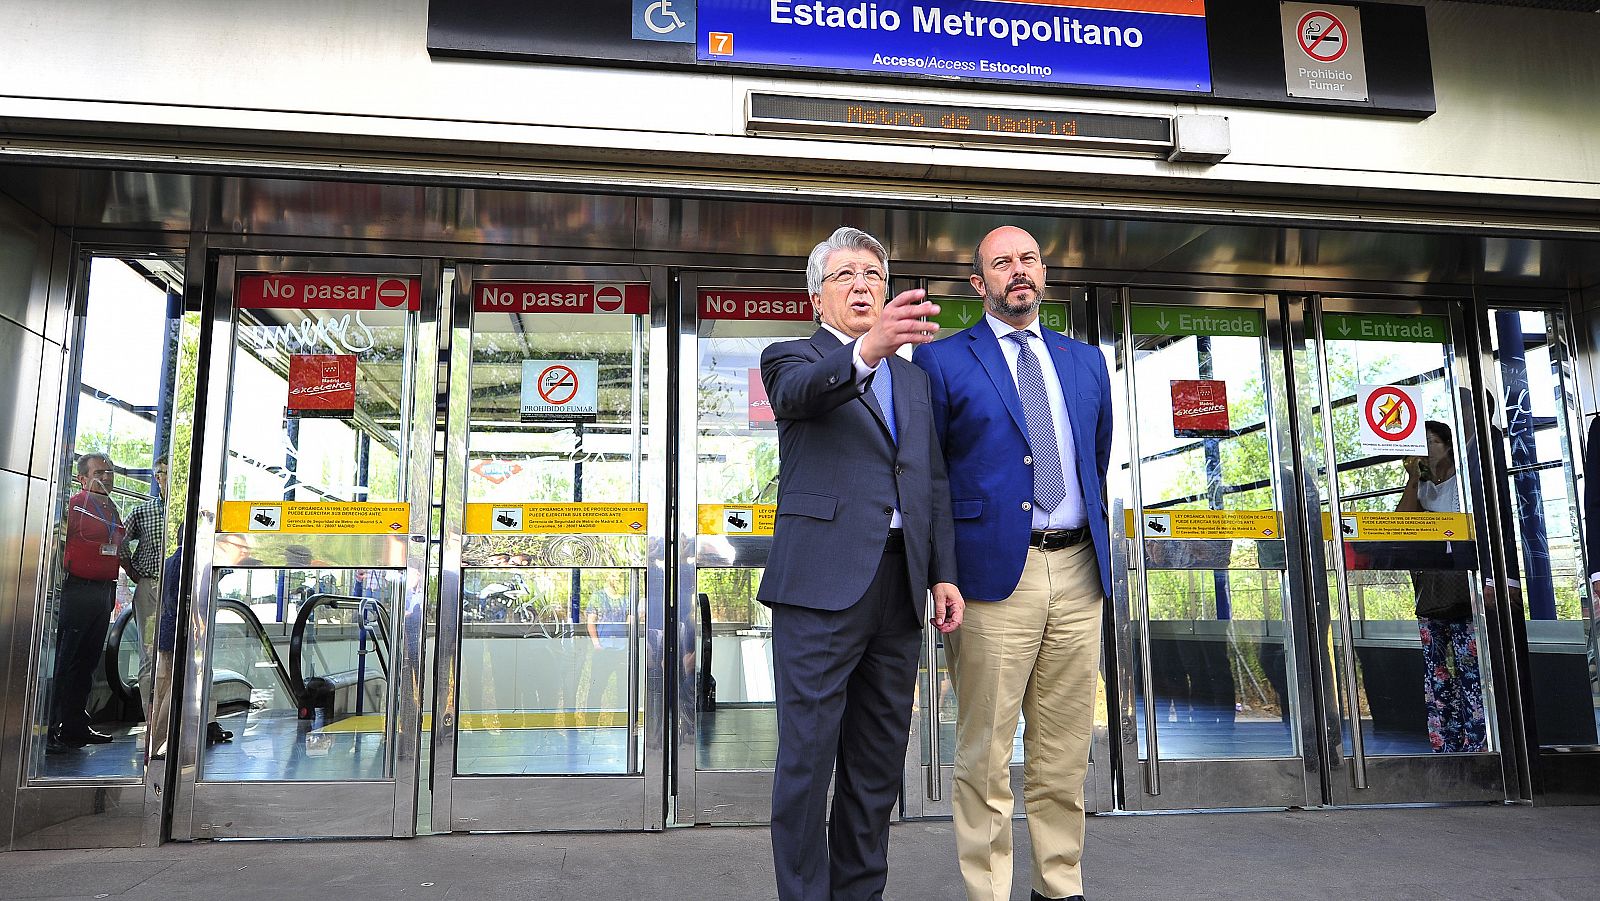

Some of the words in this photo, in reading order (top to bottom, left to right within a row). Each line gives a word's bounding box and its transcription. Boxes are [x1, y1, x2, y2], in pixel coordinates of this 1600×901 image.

[770, 0, 901, 31] Estadio
[912, 6, 1144, 48] Metropolitano
[715, 35, 729, 52] 7
[979, 60, 1052, 77] Estocolmo
[1298, 67, 1353, 81] Prohibido
[1309, 79, 1345, 92] Fumar
[847, 105, 925, 128] Metro
[940, 112, 971, 130] de
[986, 114, 1077, 136] Madrid
[262, 279, 296, 299] No
[303, 284, 371, 303] pasar
[482, 287, 514, 307] No
[522, 292, 589, 311] pasar
[706, 295, 738, 313] No
[744, 300, 808, 318] pasar
[1179, 314, 1255, 333] Entrada
[1360, 319, 1434, 338] Entrada
[524, 405, 566, 413] PROHIBIDO
[566, 405, 594, 413] FUMAR
